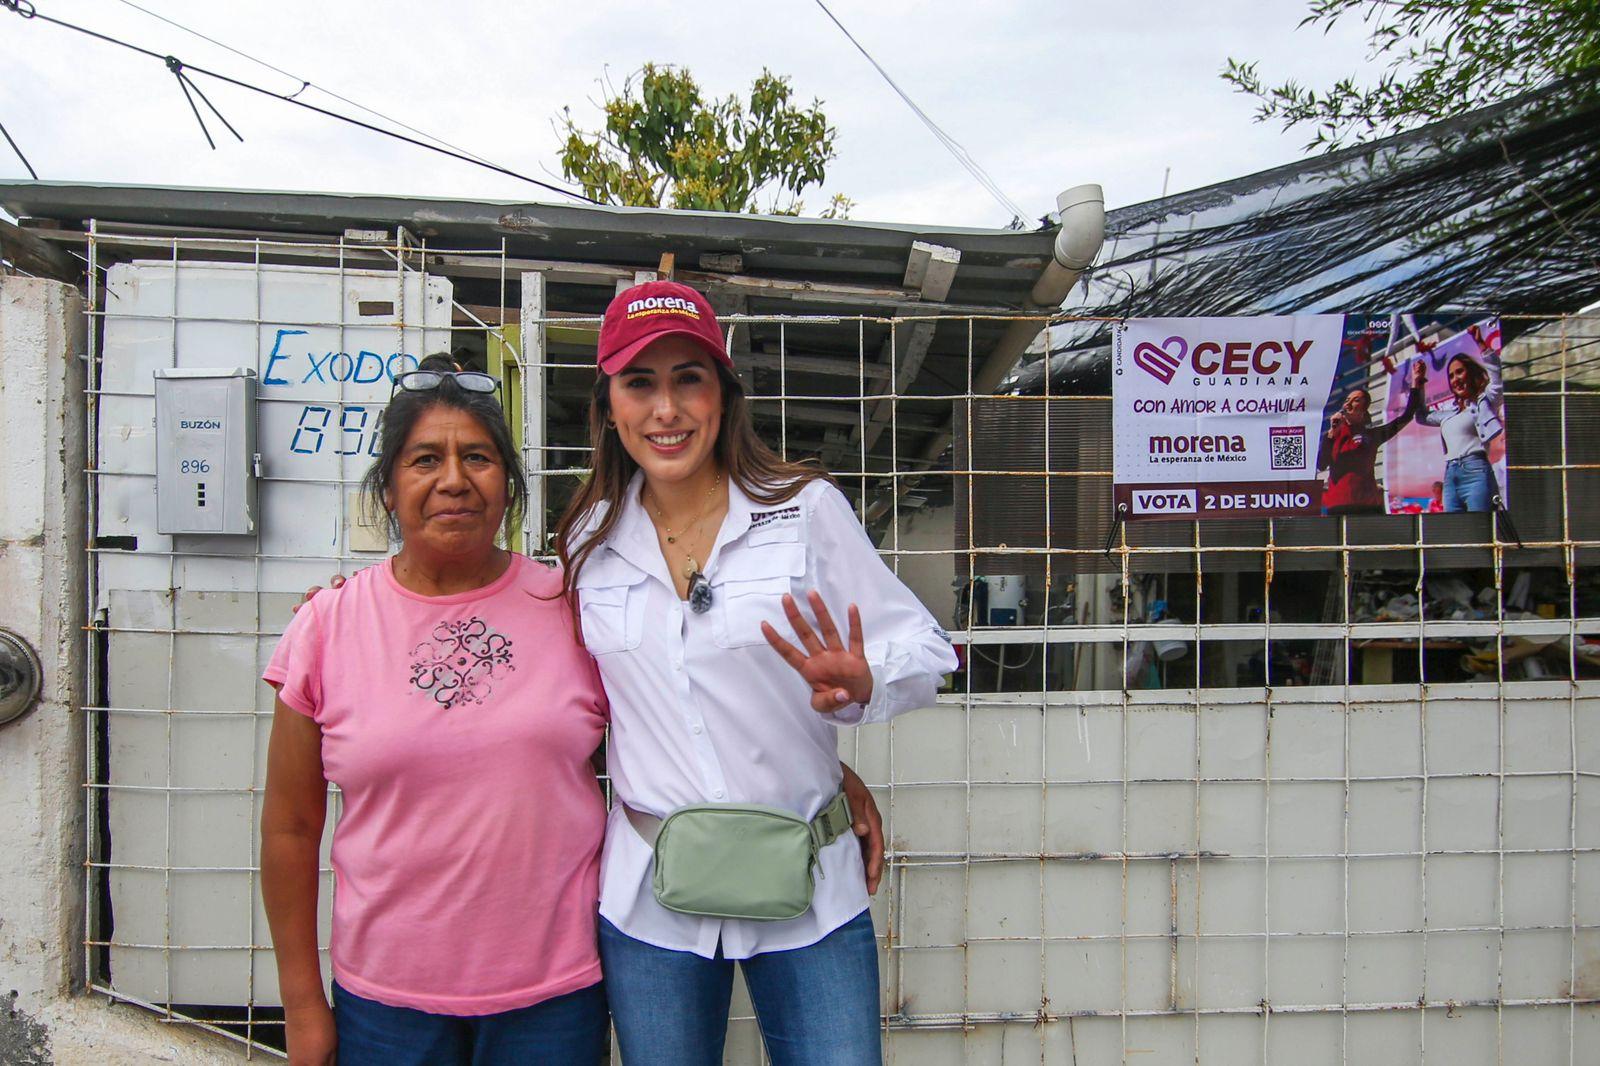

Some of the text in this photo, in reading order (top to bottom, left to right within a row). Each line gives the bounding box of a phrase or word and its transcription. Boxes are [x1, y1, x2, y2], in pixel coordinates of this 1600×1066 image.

[628, 297, 699, 314] morena
[1191, 340, 1314, 376] CECY
[1193, 376, 1309, 387] GUADIANA
[1221, 398, 1231, 414] A
[1236, 398, 1306, 414] COAHUILA
[180, 420, 221, 429] BUZÓN
[1149, 434, 1247, 454] morena
[181, 460, 210, 473] 896
[1161, 455, 1202, 465] esperanza
[1204, 454, 1215, 462] de
[1217, 454, 1247, 463] México
[1138, 493, 1310, 510] VOTA 2 DE JUNIO
